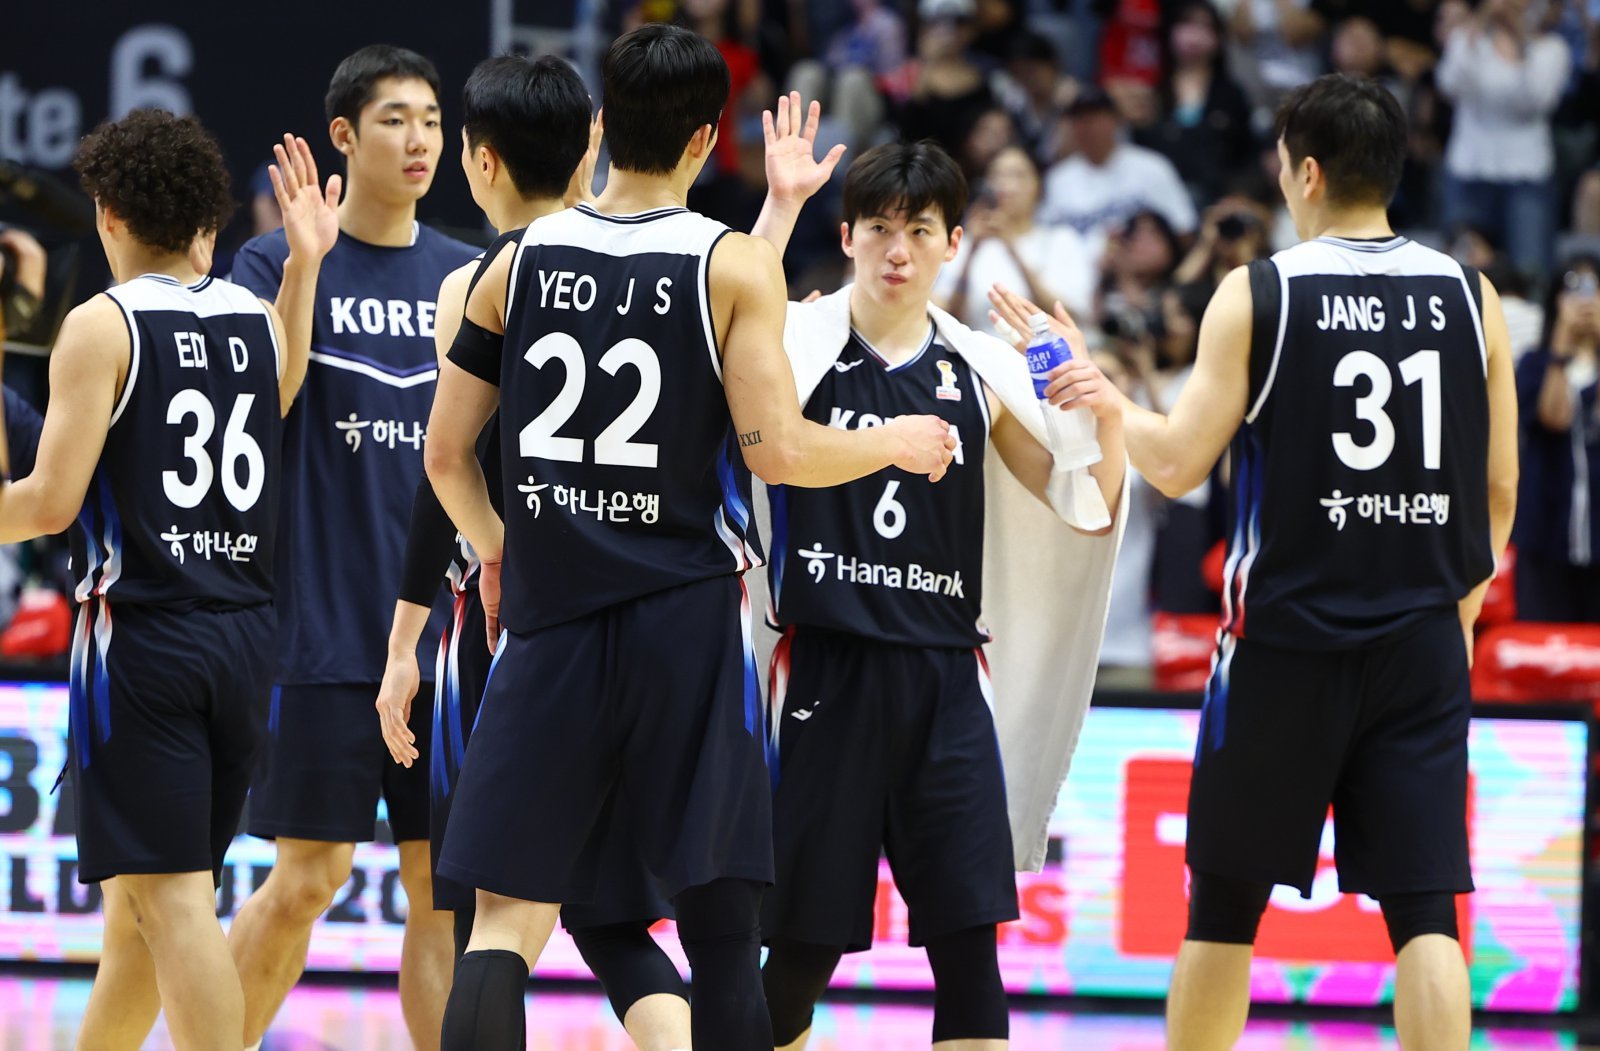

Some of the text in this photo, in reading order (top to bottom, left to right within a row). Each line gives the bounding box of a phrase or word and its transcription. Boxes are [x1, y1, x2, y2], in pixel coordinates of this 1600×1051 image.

[112, 24, 194, 122] 6
[538, 269, 673, 316] YEO J S
[1316, 294, 1446, 332] JANG J S
[330, 296, 437, 338] KORE
[228, 336, 249, 373] D
[518, 331, 662, 469] 22
[1331, 349, 1442, 471] 31
[162, 388, 265, 512] 36
[372, 419, 427, 450] 하나
[739, 430, 763, 447] XXII
[552, 484, 660, 524] 하나은행
[873, 479, 907, 539] 6
[1356, 492, 1450, 526] 하나은행
[837, 554, 965, 599] Hana Bank
